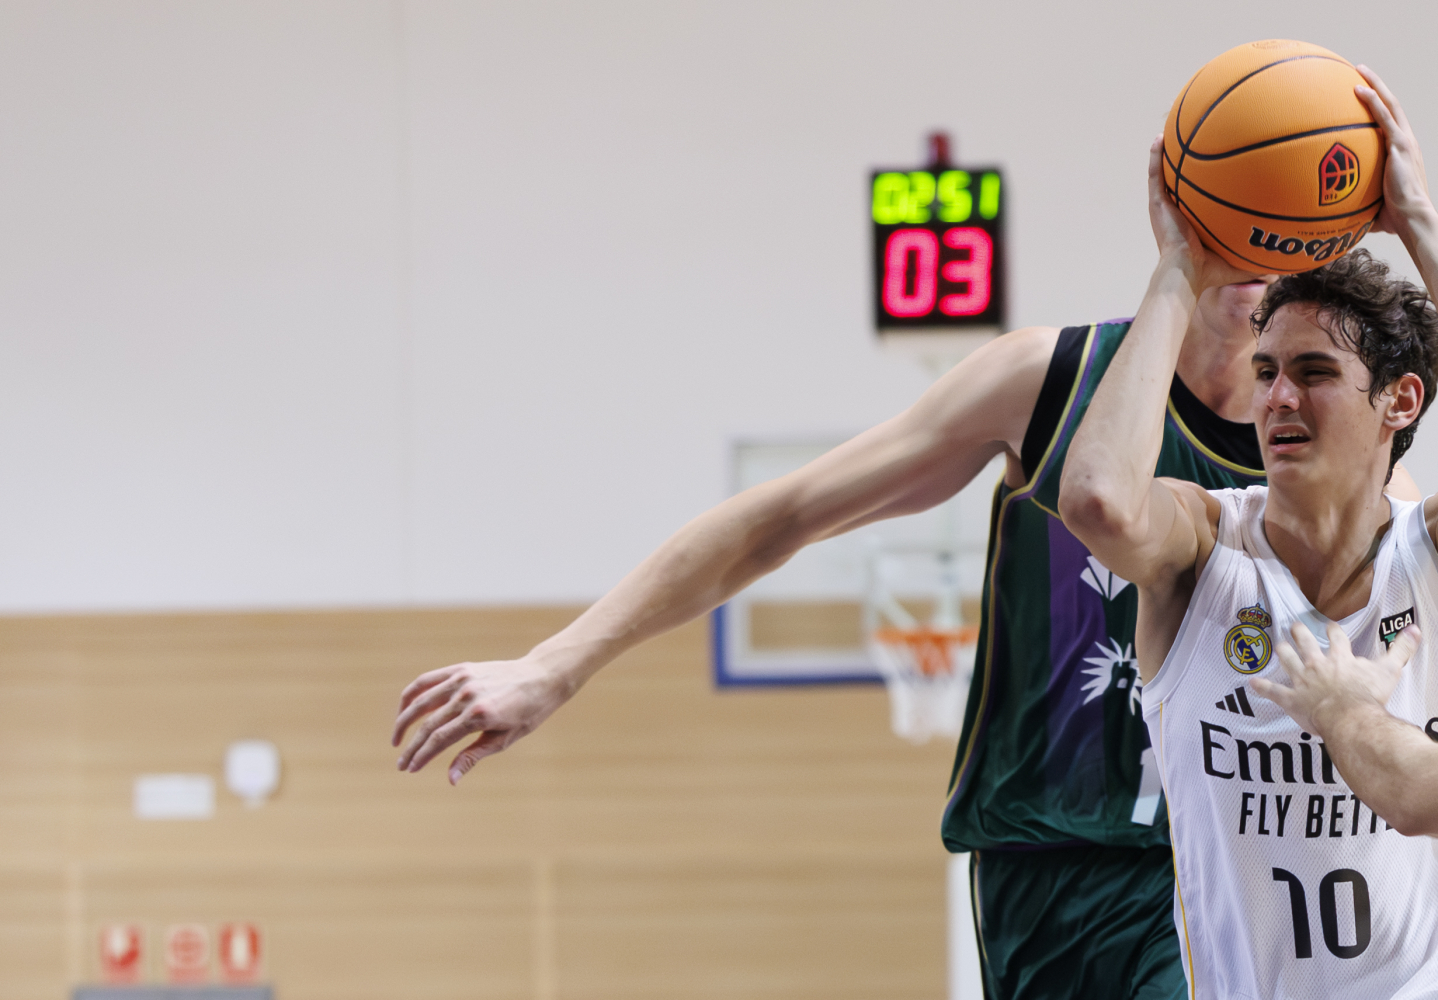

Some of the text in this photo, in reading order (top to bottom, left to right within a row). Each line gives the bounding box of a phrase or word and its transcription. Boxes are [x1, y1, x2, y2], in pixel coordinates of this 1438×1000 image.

[882, 226, 993, 318] 03
[1381, 612, 1412, 636] LIGA
[1239, 792, 1394, 838] FLY BET
[1272, 866, 1371, 959] 10
